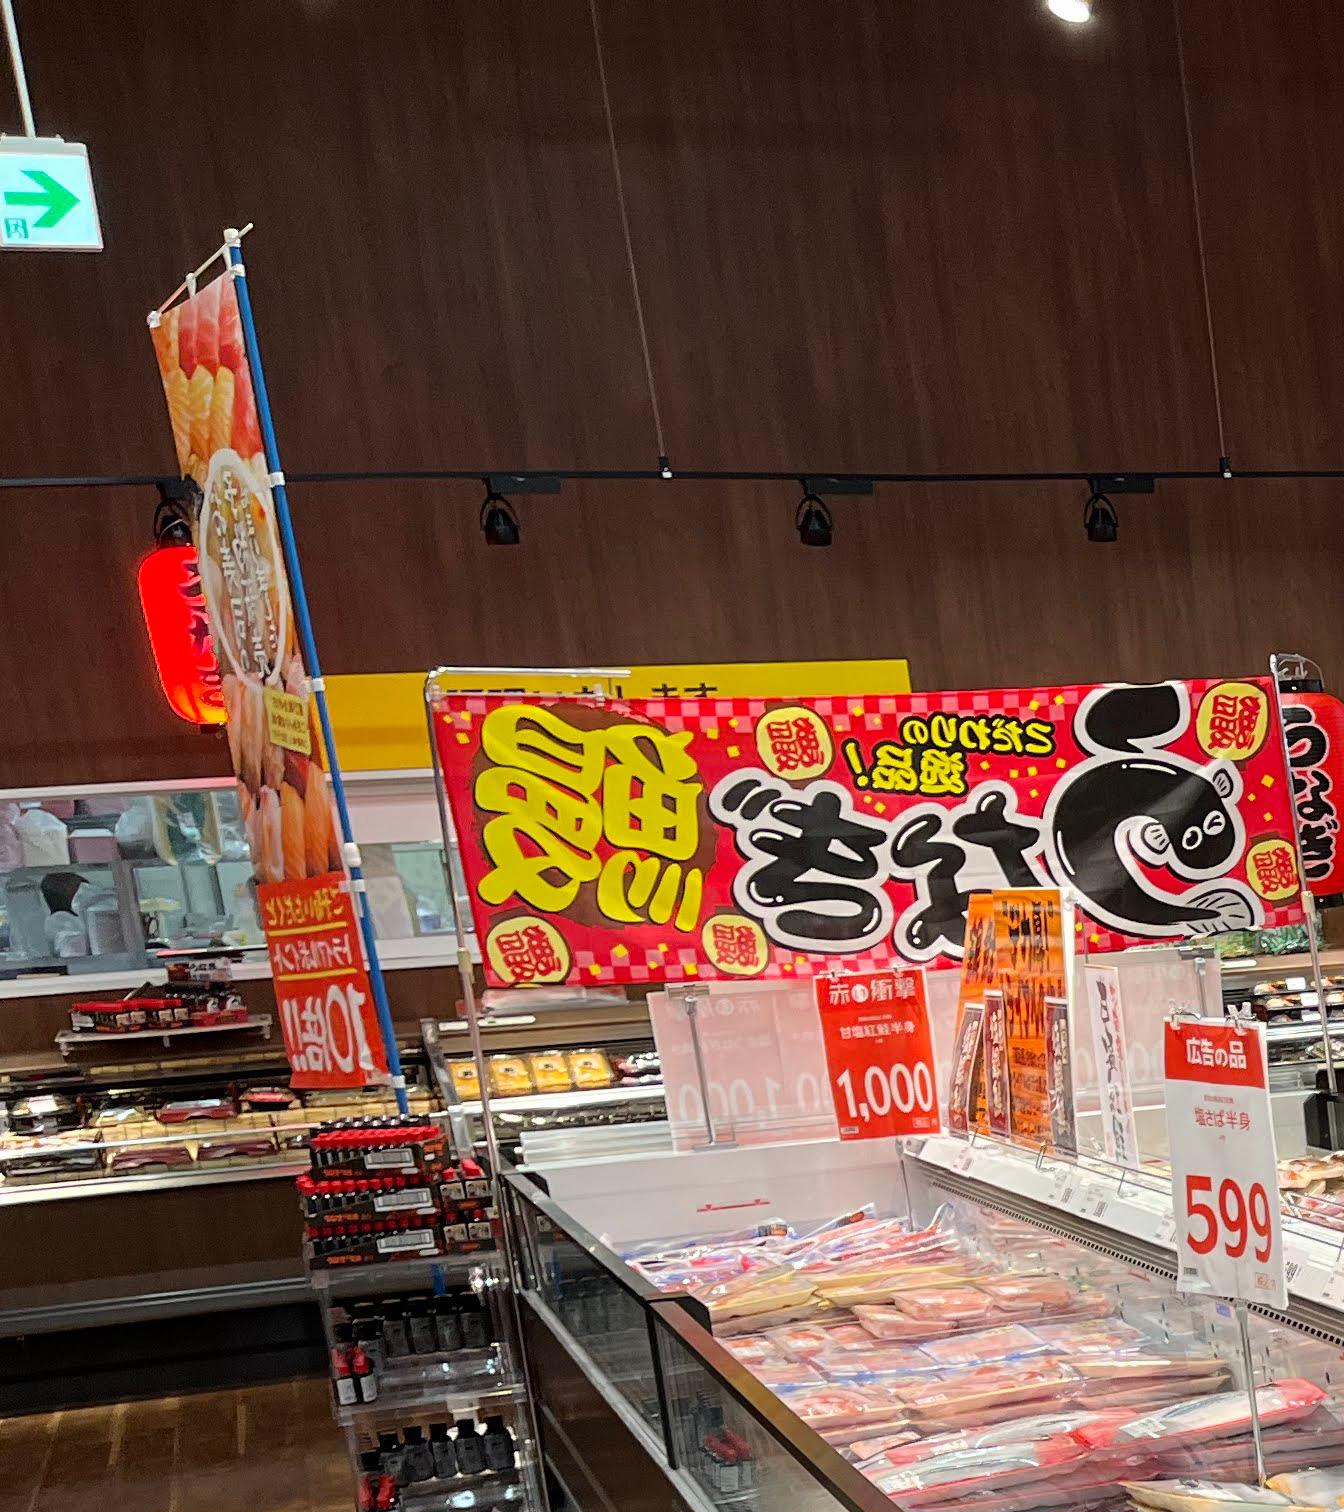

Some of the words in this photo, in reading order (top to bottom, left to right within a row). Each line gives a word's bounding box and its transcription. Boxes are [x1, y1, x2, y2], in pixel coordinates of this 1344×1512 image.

[1186, 1038, 1247, 1069] 広告の品
[836, 1062, 933, 1122] 1,000
[1186, 1175, 1272, 1263] 599
